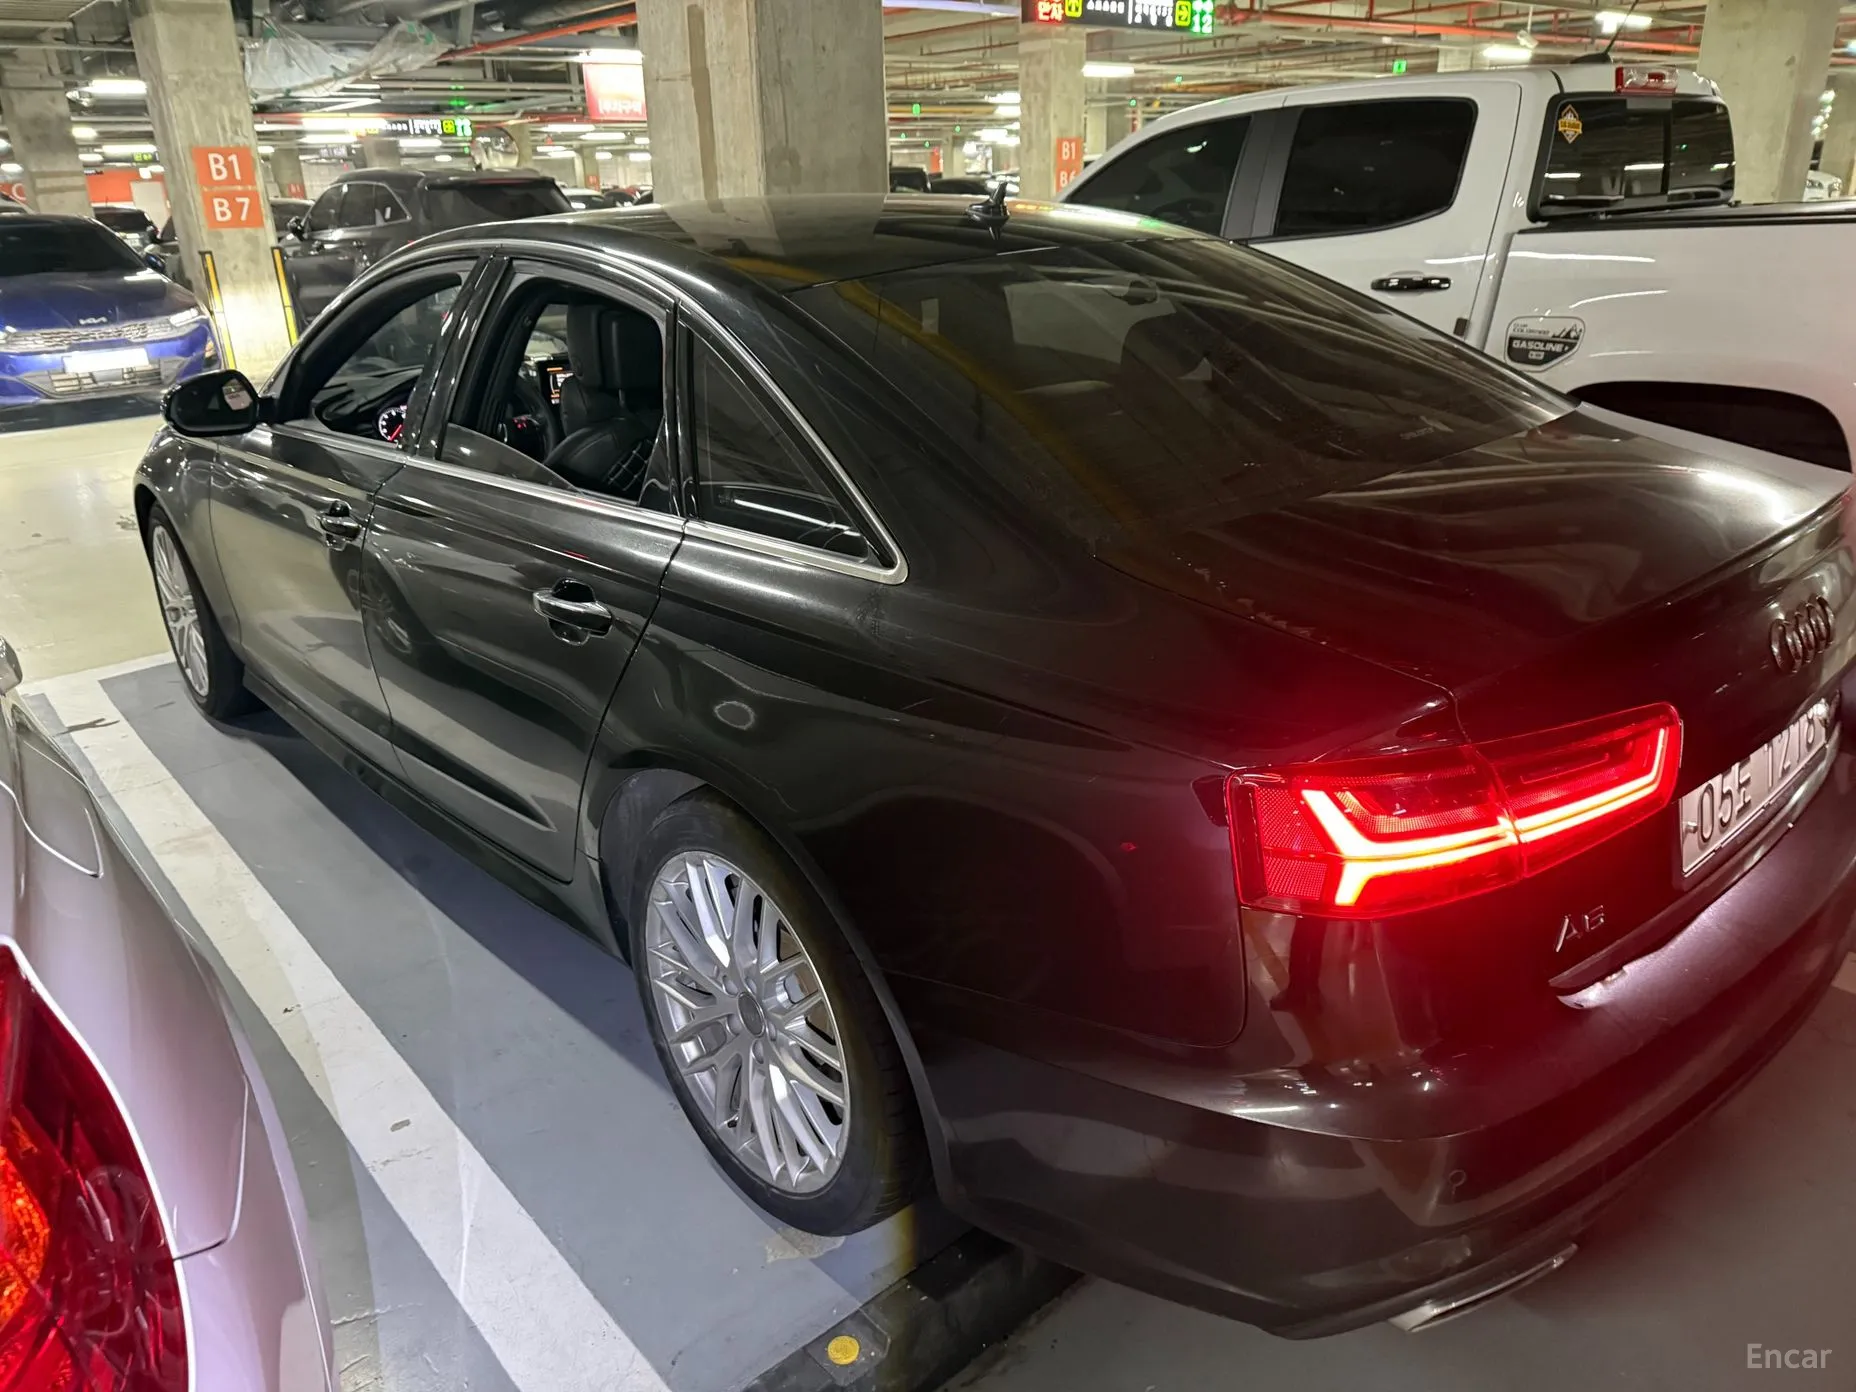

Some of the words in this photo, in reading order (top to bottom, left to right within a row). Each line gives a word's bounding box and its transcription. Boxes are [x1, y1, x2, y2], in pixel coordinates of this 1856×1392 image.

[1062, 140, 1076, 160] B1
[208, 153, 241, 180] B1
[1512, 339, 1564, 353] GASOLINE
[1554, 904, 1604, 953] A6
